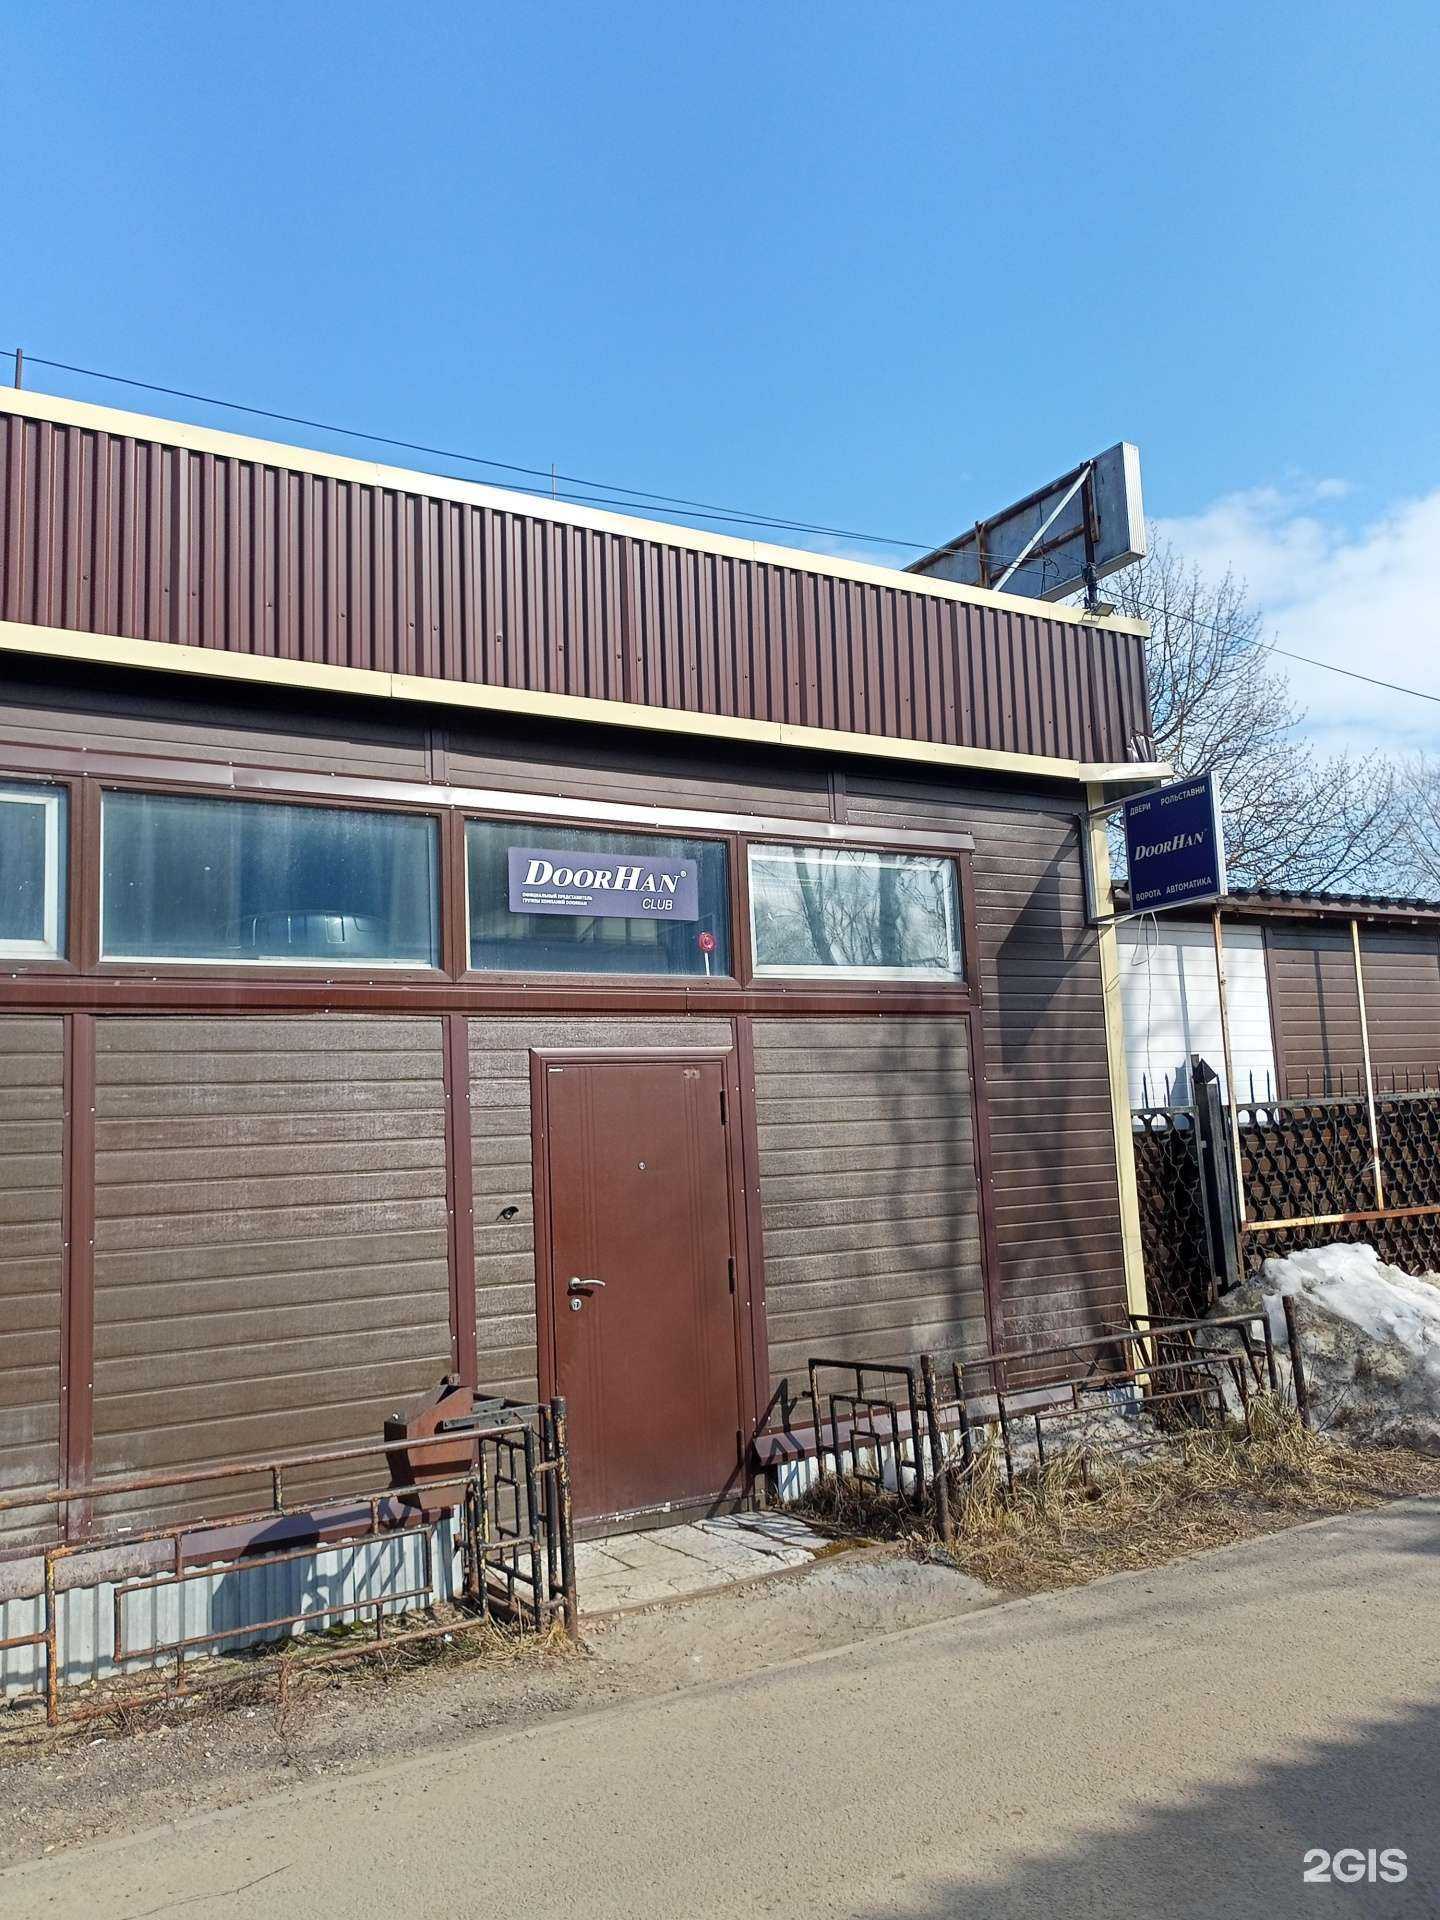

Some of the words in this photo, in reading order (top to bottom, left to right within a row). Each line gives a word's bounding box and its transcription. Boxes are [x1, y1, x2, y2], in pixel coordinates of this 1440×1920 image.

[1130, 802, 1151, 816] ДВЕРИ
[1160, 785, 1205, 806] РОЛЬСТАВНИ
[1135, 888, 1161, 902] ВОРОТА
[1166, 876, 1212, 895] АВТОМАТИКА
[642, 897, 673, 911] CLUB
